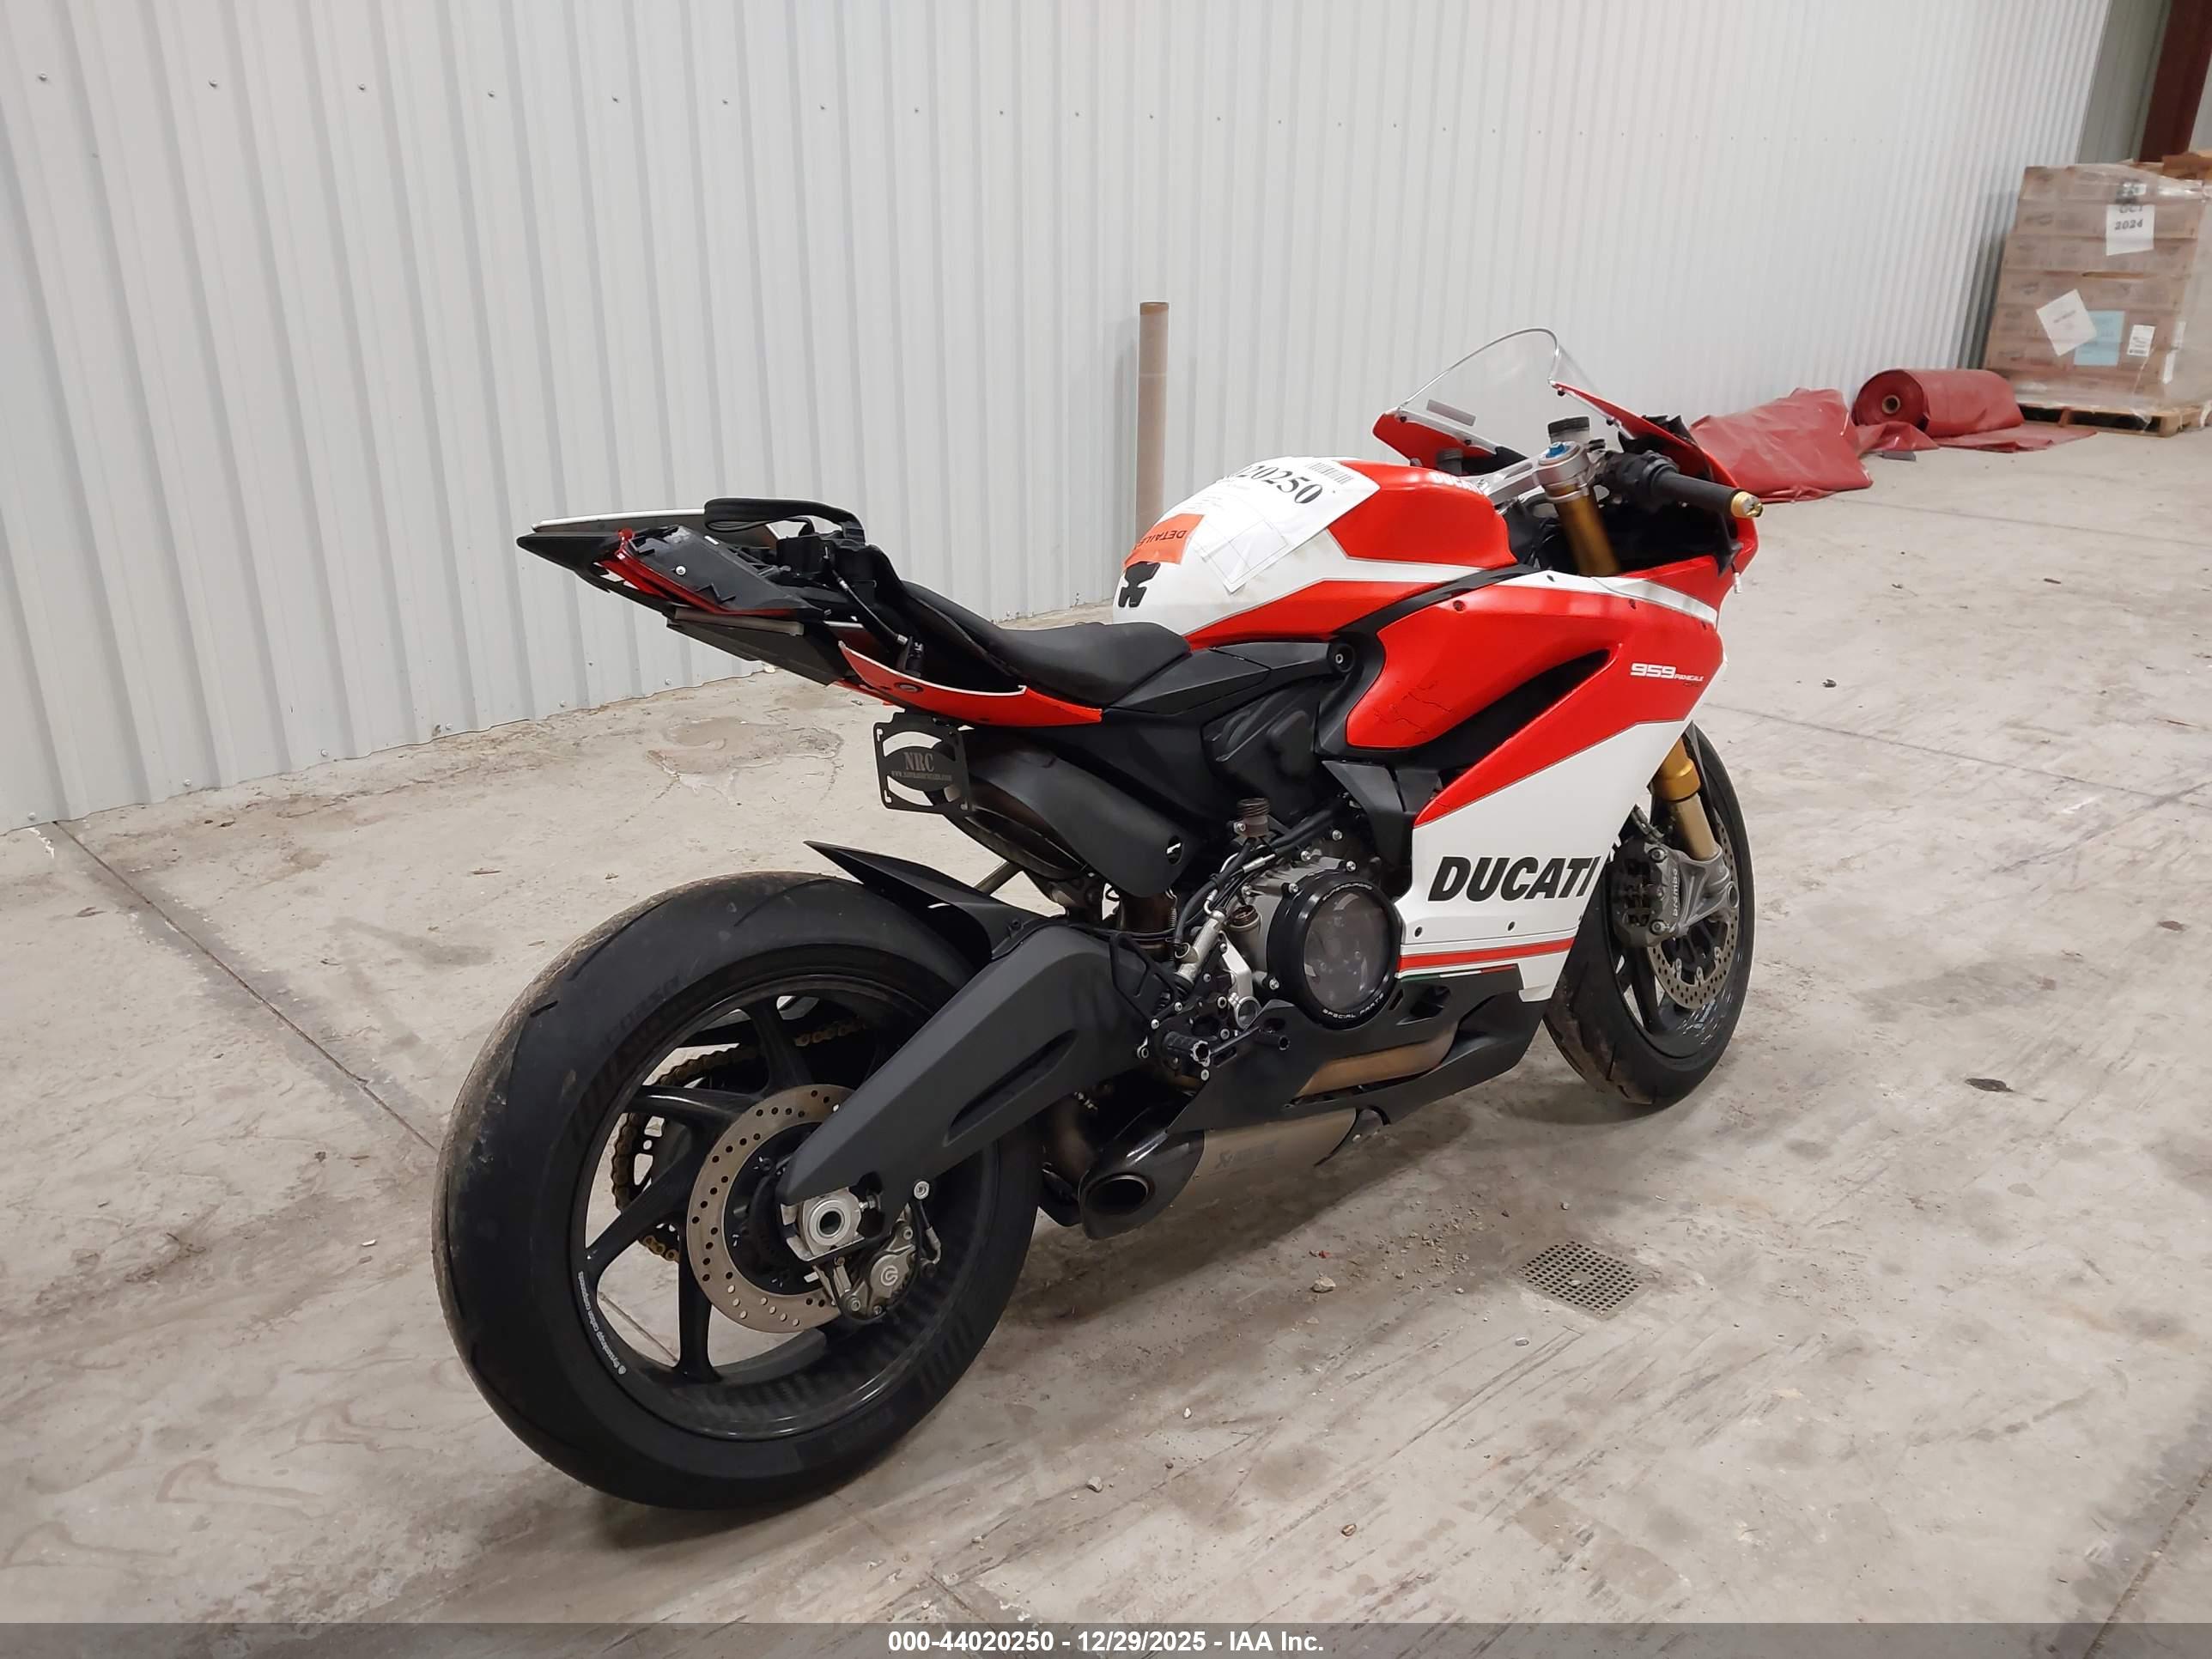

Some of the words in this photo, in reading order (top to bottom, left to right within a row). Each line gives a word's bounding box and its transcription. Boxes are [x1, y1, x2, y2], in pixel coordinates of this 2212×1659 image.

[2114, 218, 2144, 230] 2024
[1224, 465, 1323, 504] 20250
[1134, 530, 1188, 550] DETAILE
[1630, 662, 1676, 679] 959
[903, 751, 935, 772] NRC
[1427, 856, 1601, 902] DUCATI
[1322, 1008, 1357, 1019] SPECIAL
[1359, 993, 1384, 1015] PARTS
